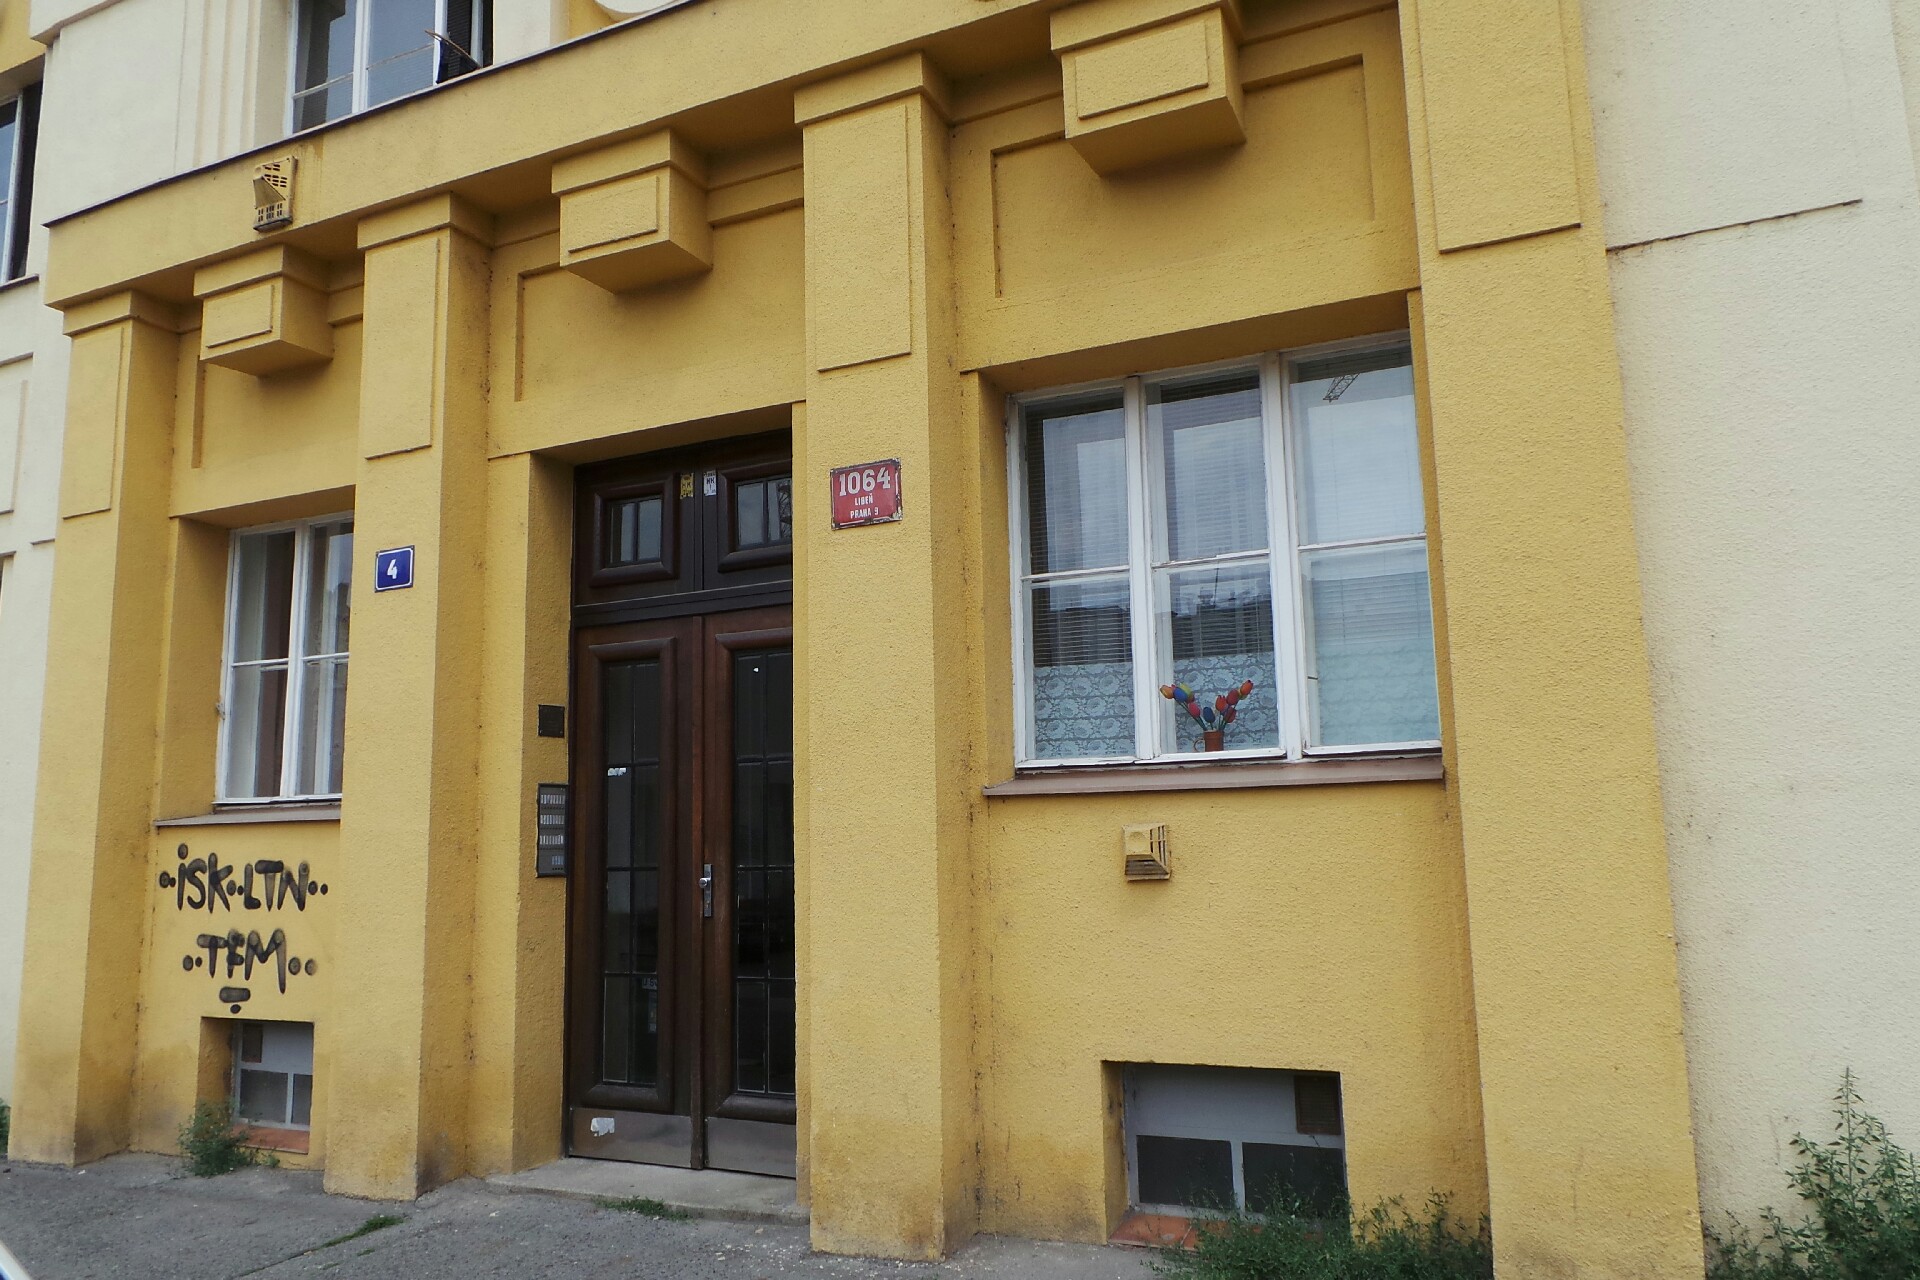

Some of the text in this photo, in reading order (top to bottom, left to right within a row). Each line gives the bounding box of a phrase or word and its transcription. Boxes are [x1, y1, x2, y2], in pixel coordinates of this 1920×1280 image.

[839, 467, 891, 497] 1064
[854, 492, 873, 506] LIBEŇ
[850, 507, 879, 519] PRAHA 9
[387, 559, 397, 578] 4
